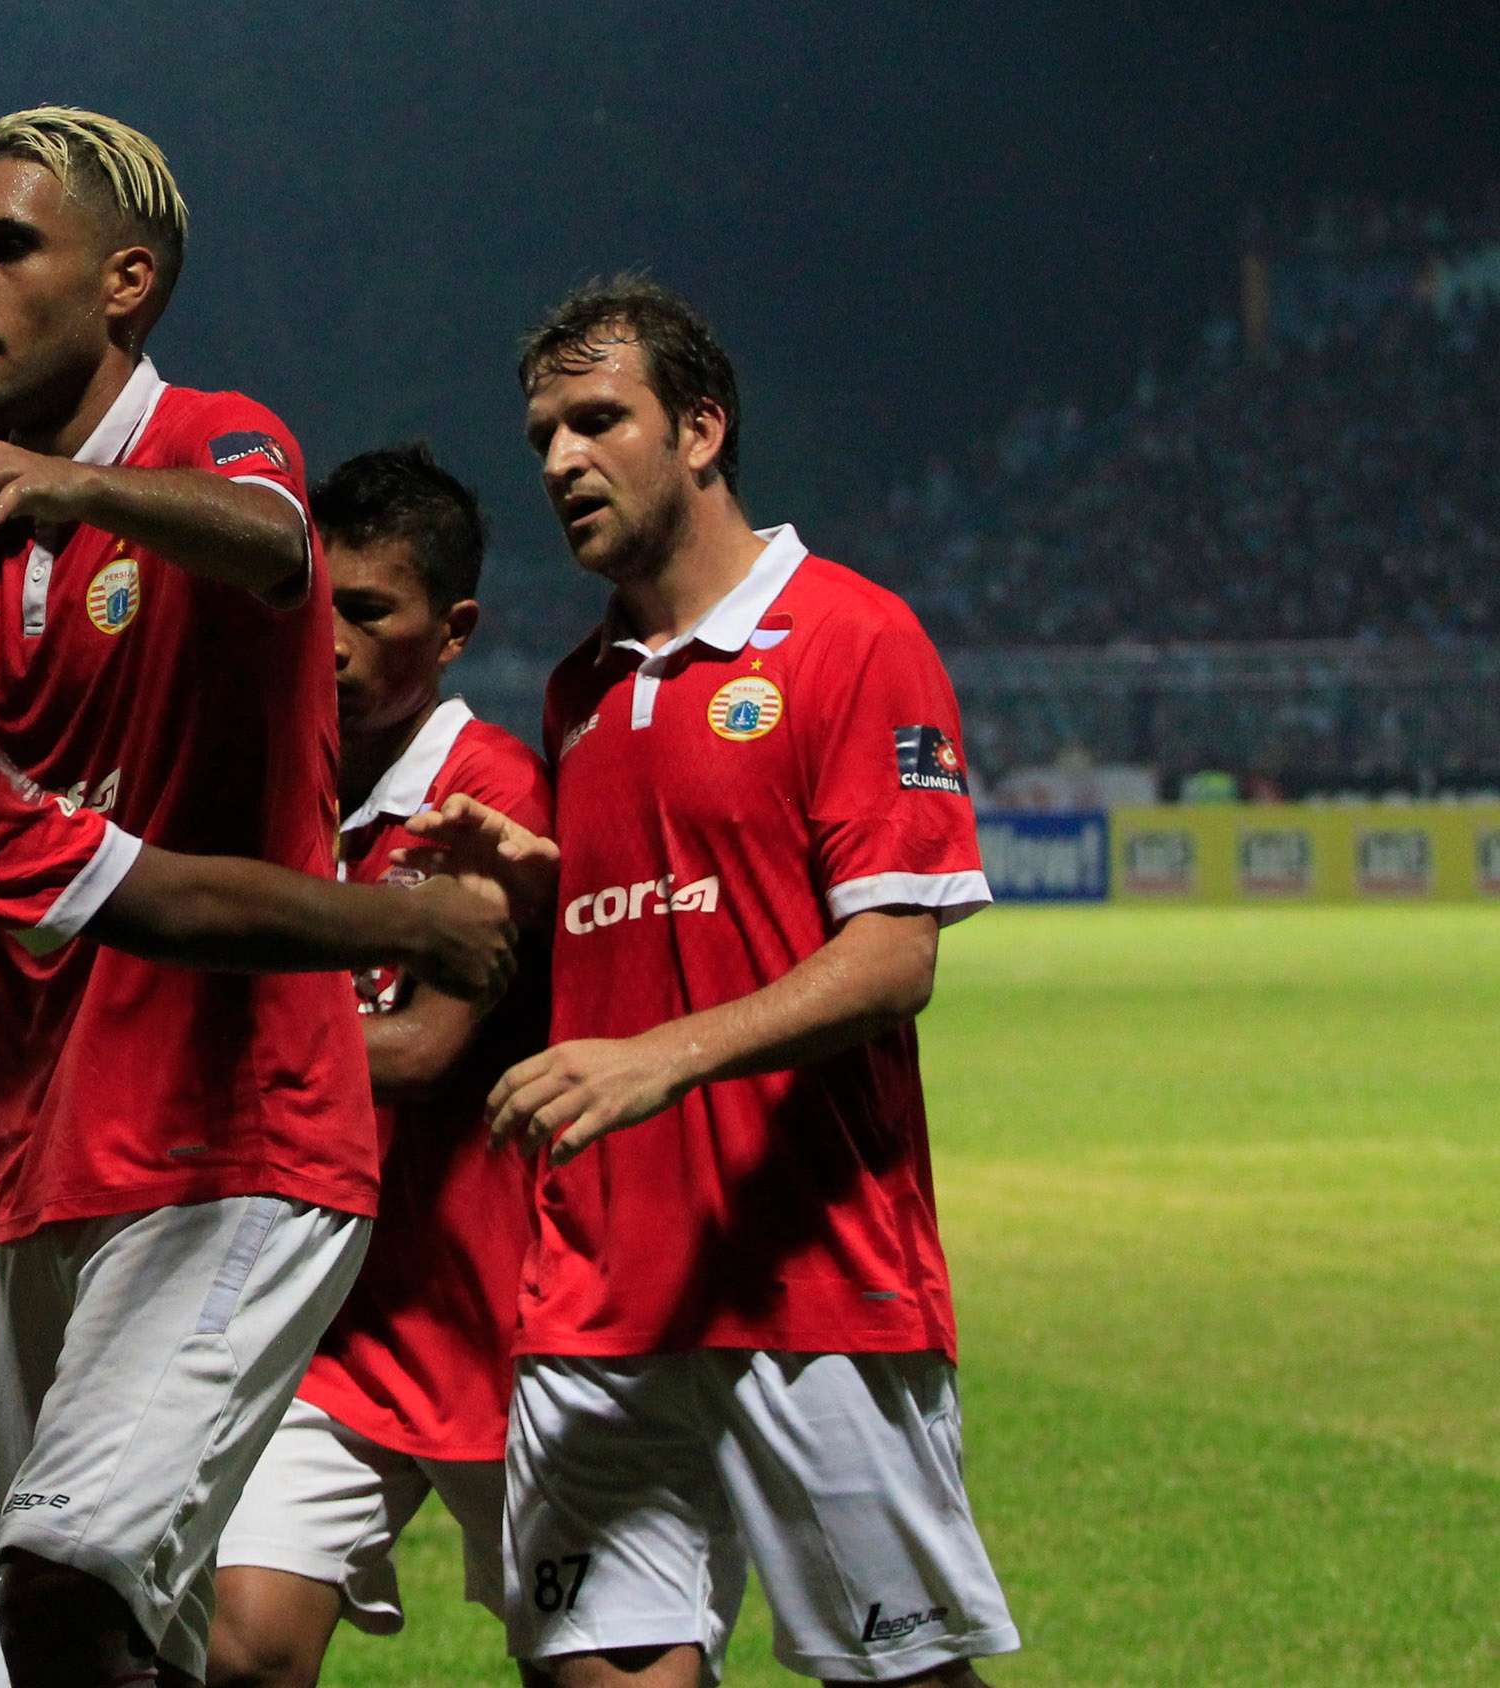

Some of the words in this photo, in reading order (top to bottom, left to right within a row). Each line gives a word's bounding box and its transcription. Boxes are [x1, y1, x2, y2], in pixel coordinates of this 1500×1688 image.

[900, 771, 961, 793] COLUMBIA
[534, 1553, 592, 1613] 87
[861, 1602, 949, 1643] League
